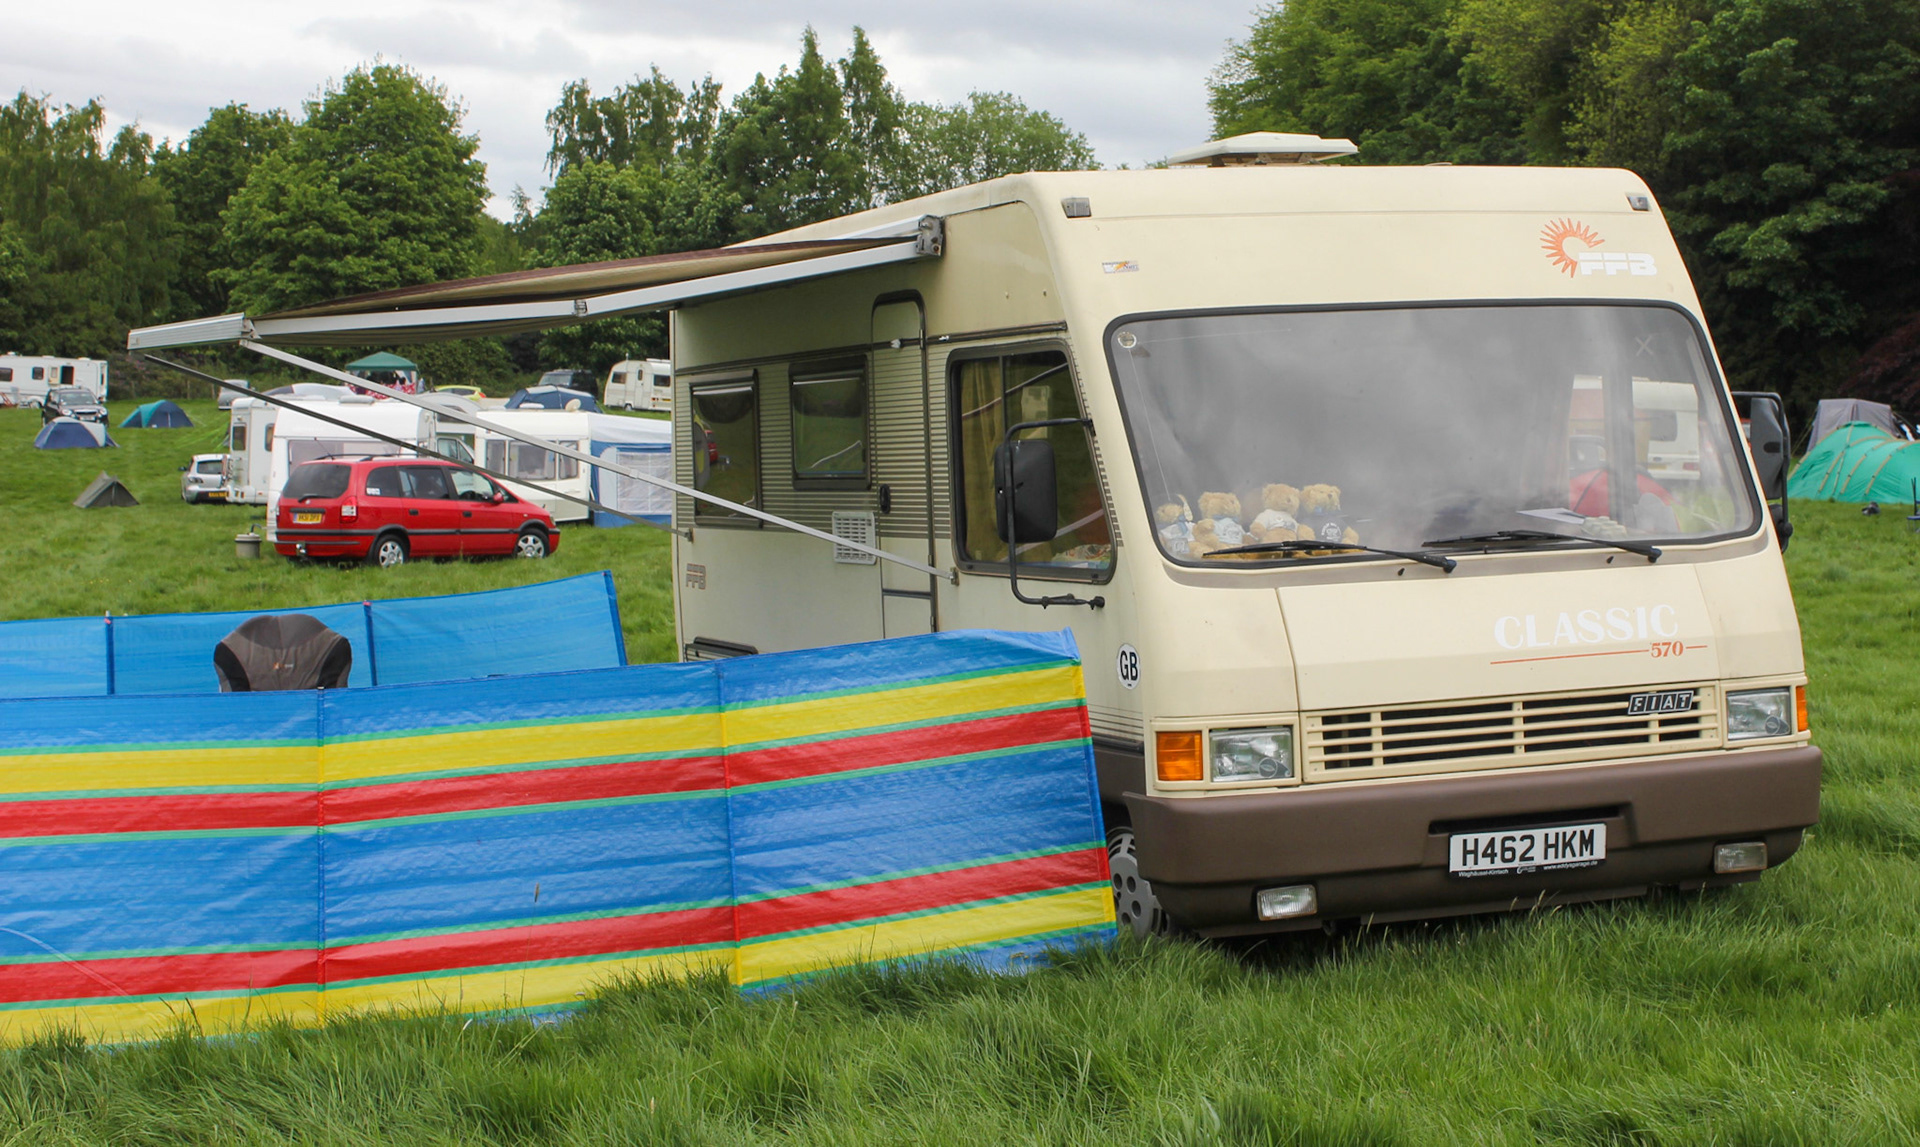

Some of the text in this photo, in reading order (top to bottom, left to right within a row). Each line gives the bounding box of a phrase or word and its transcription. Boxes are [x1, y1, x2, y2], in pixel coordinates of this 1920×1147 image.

[1578, 251, 1657, 276] FFB
[1493, 603, 1679, 650] CLASSIC
[1650, 640, 1684, 658] 570
[1119, 650, 1138, 681] GB
[1630, 692, 1692, 713] FIAT
[1462, 828, 1595, 866] H462 HKM
